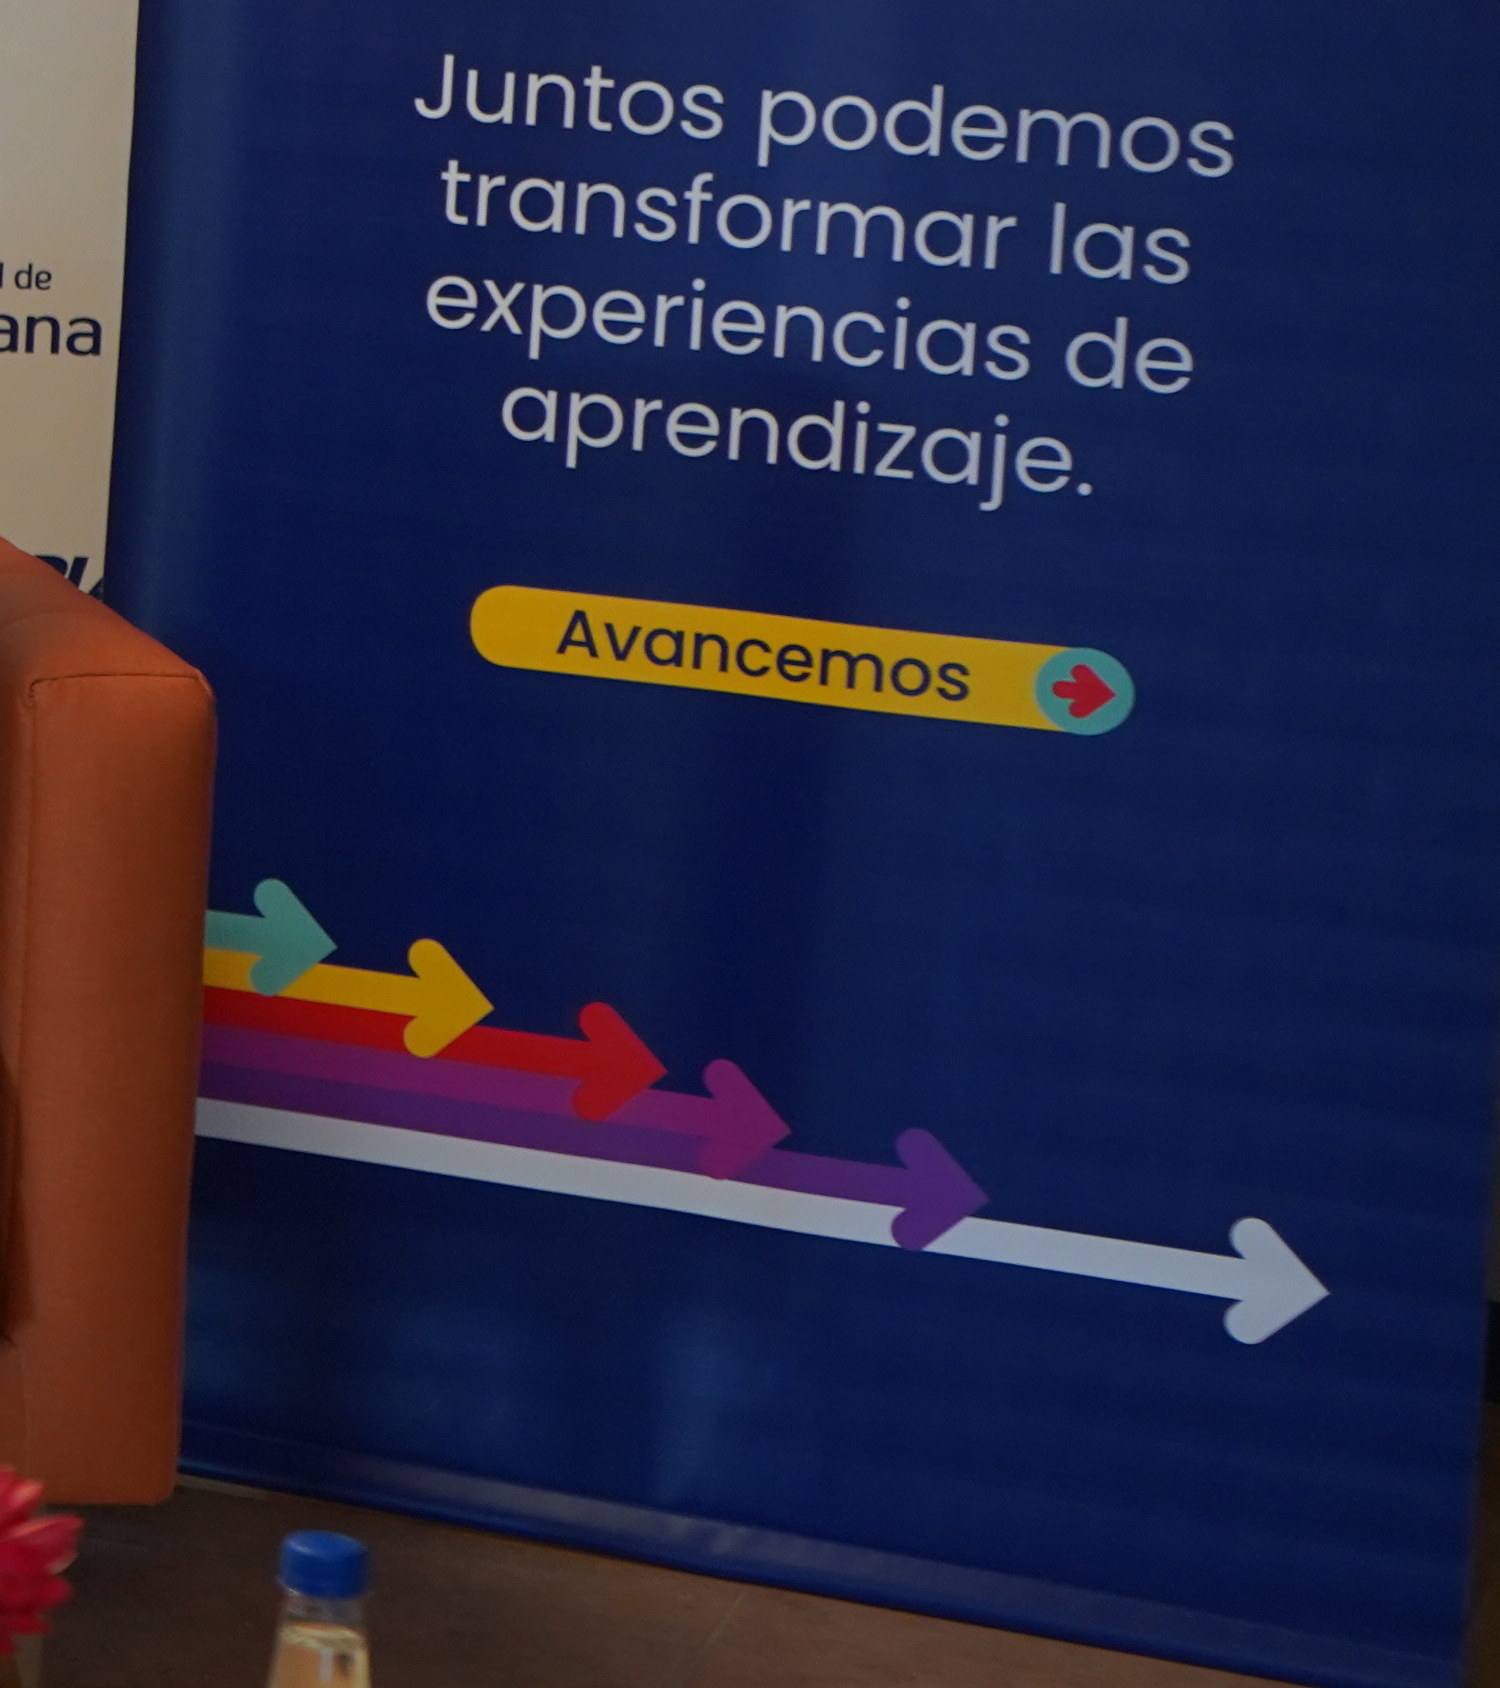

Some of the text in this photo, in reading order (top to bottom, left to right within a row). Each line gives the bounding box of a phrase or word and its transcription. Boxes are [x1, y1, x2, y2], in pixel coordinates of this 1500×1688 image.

[414, 53, 1234, 178] Juntos podemos
[14, 263, 53, 291] de
[440, 159, 1191, 285] transformar las
[426, 275, 1194, 394] experiencias de
[501, 386, 1093, 512] aprendizaje.
[556, 609, 970, 702] Avancemos
